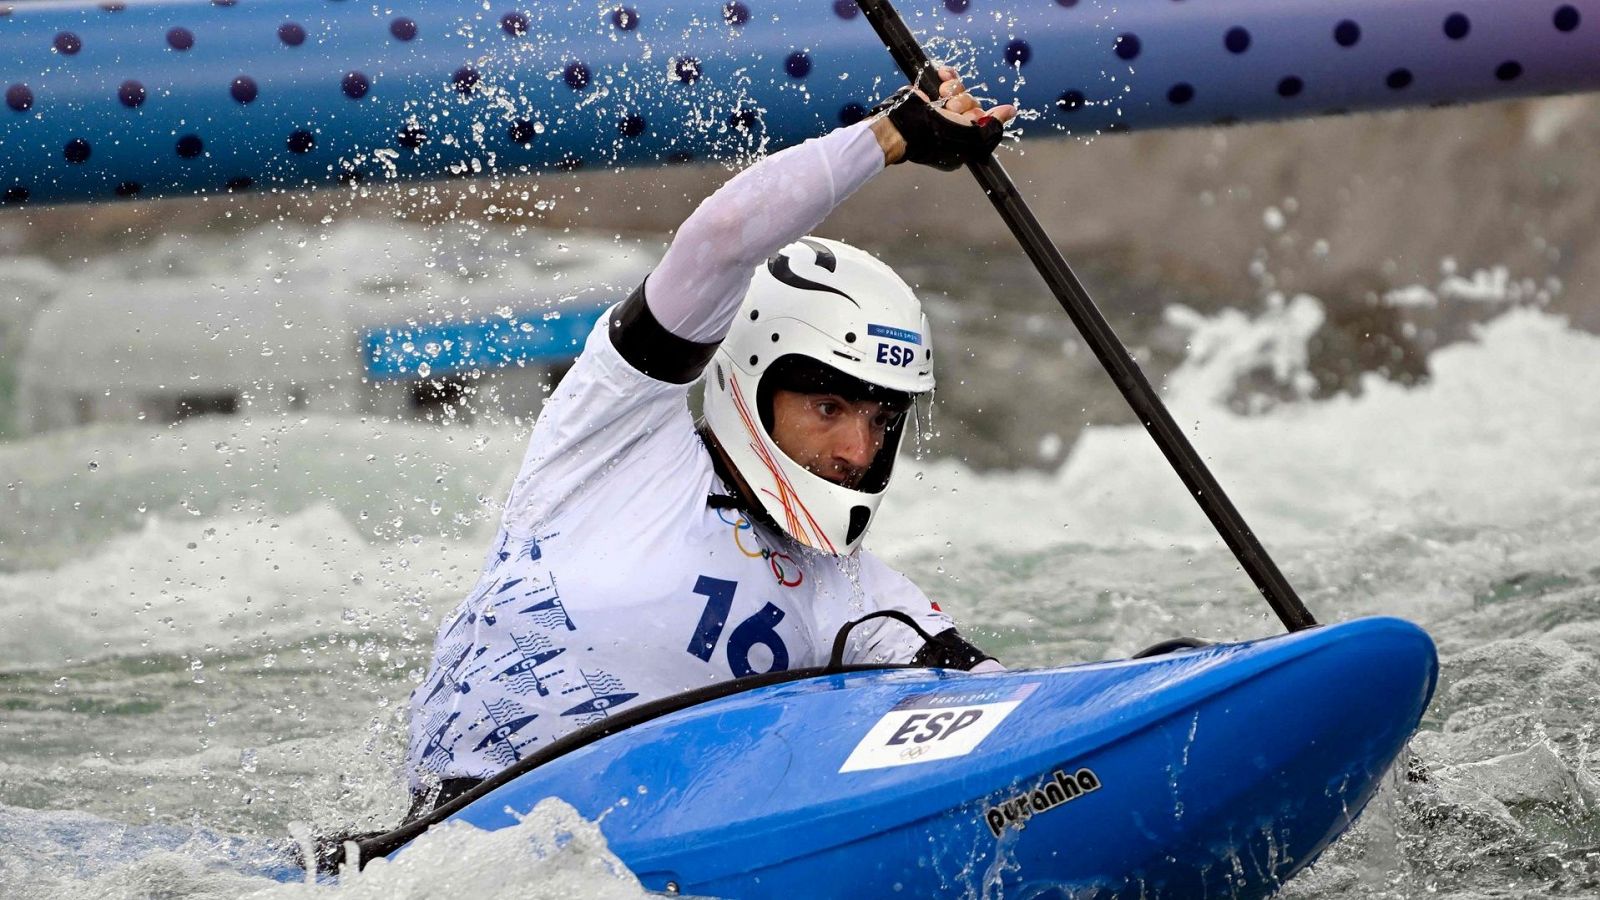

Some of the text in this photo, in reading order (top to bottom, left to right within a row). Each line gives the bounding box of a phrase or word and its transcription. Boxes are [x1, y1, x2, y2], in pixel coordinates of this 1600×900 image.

[885, 329, 903, 338] PARIS
[876, 343, 914, 368] ESP
[687, 575, 789, 679] 16
[928, 695, 966, 704] PARIS
[886, 710, 983, 746] ESP
